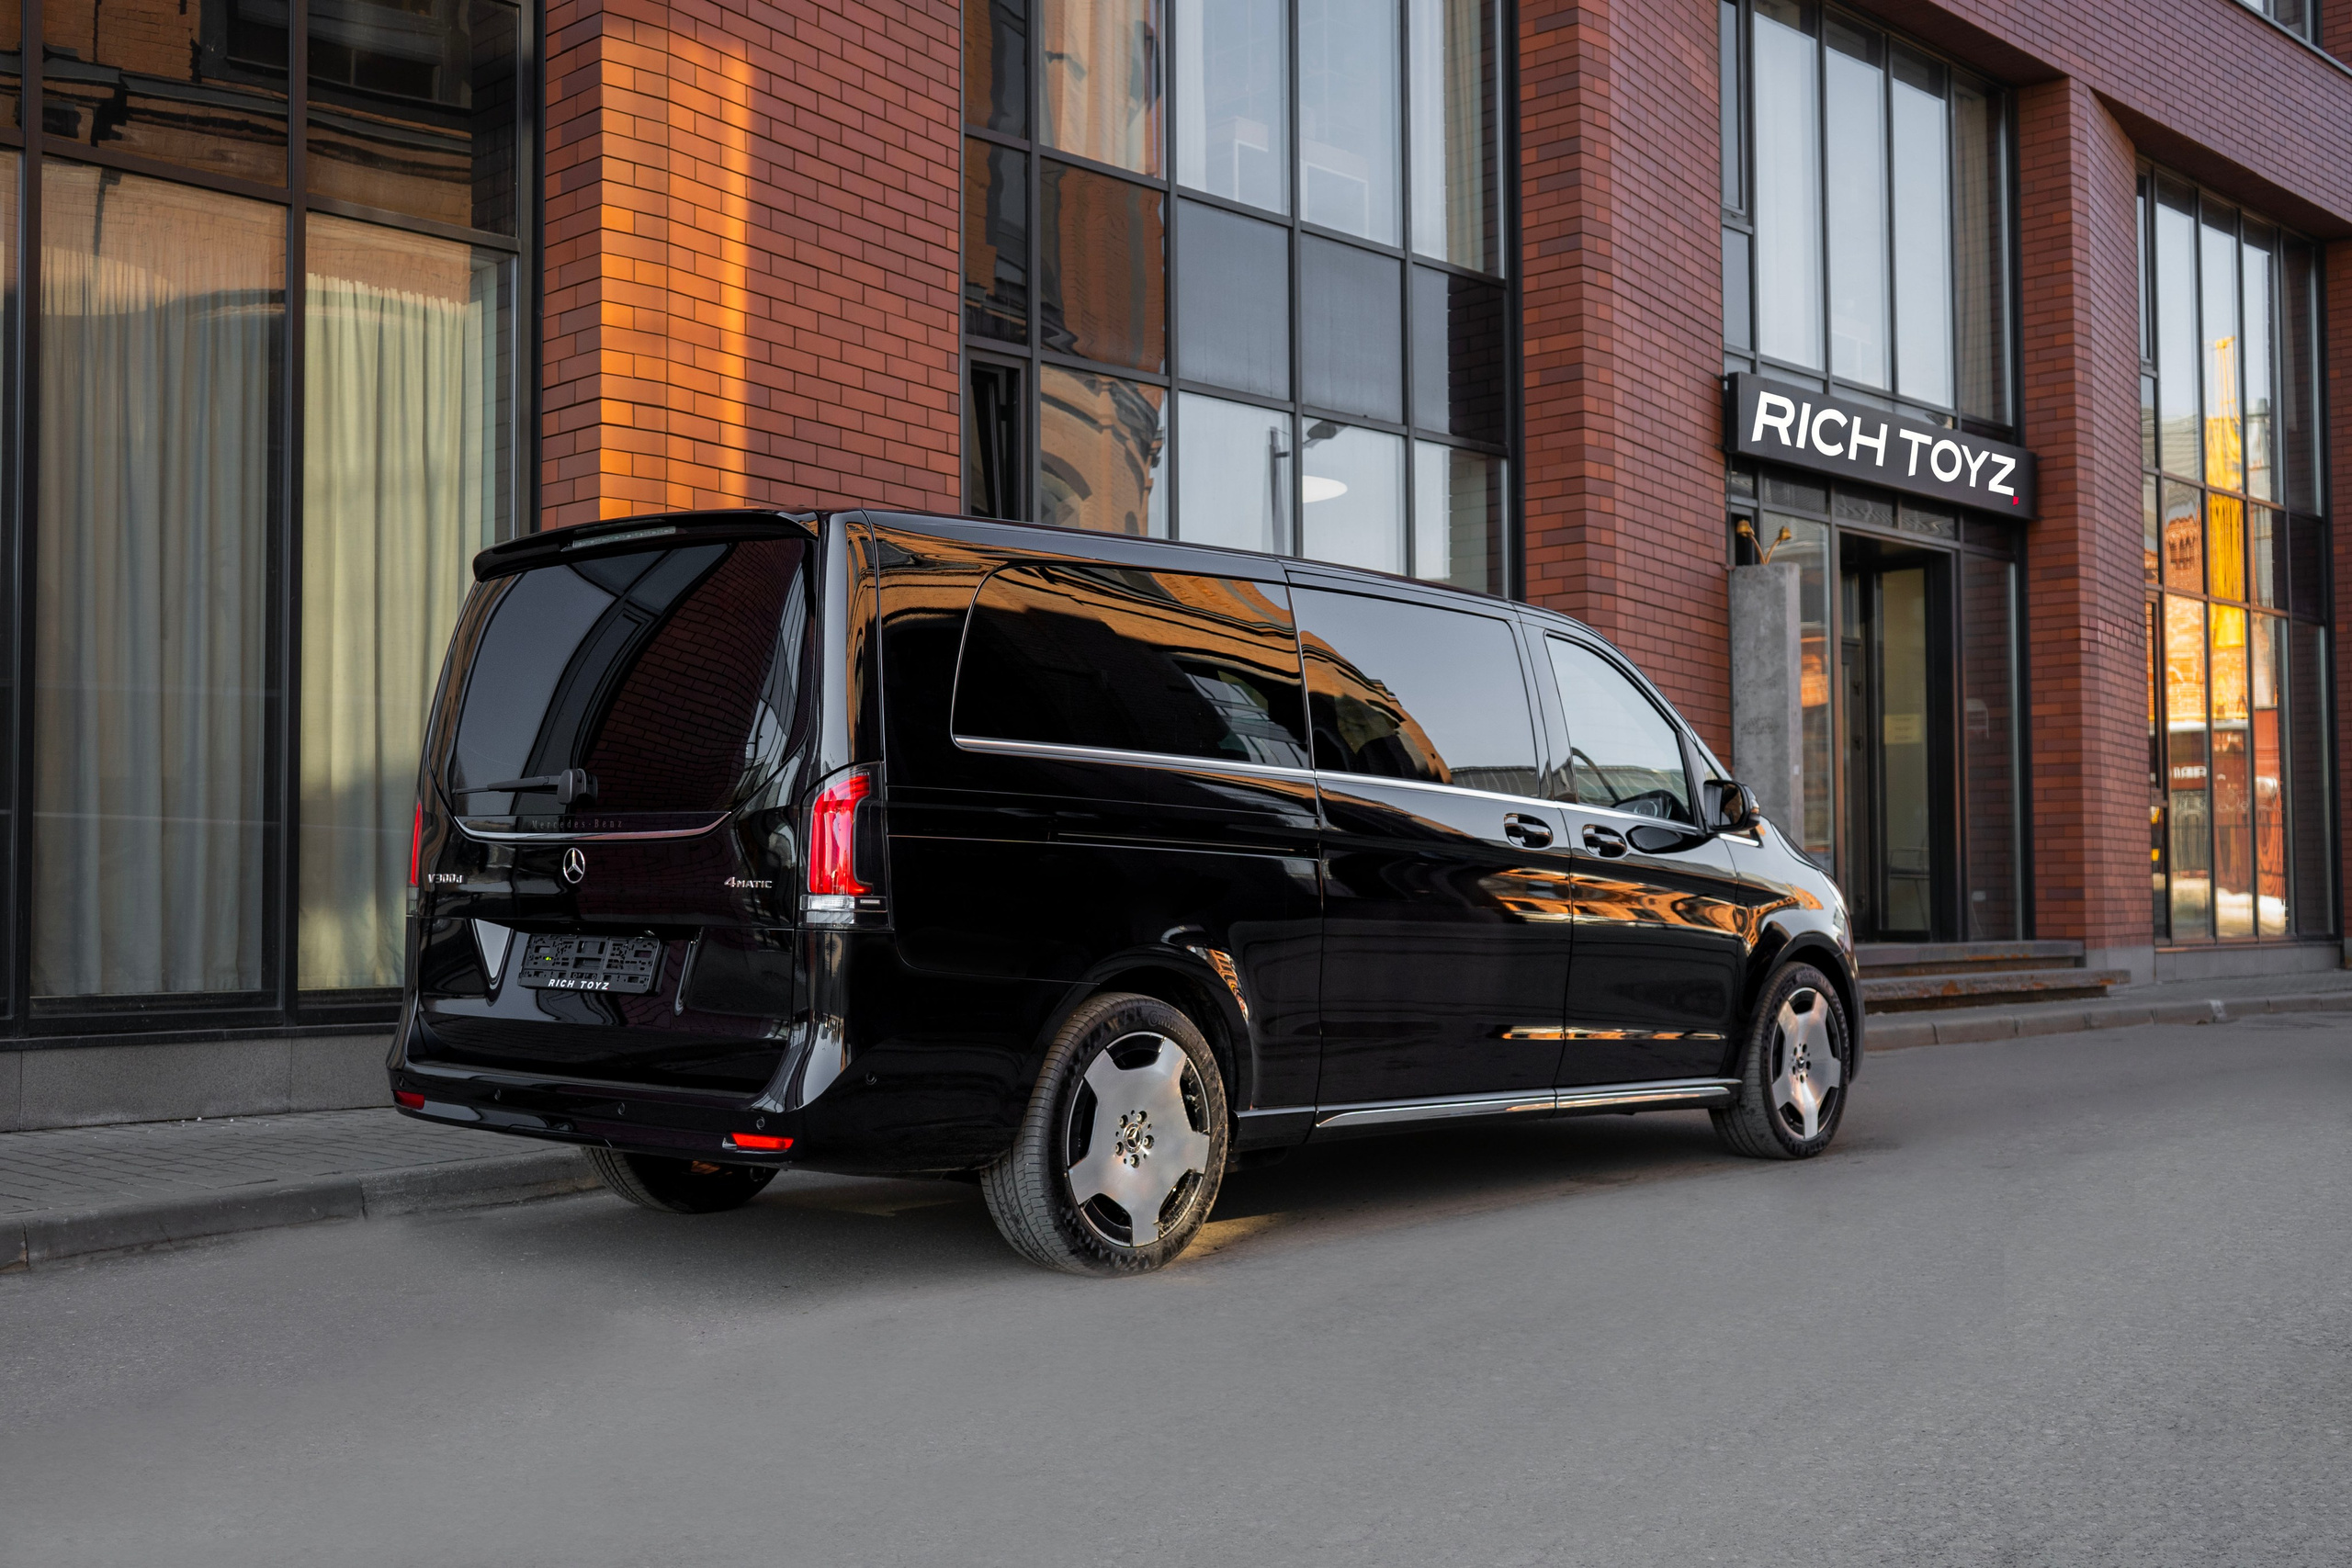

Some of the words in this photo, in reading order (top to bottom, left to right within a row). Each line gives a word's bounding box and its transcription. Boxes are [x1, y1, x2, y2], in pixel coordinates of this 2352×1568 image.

[1751, 390, 1888, 468] RICH
[724, 876, 773, 888] 4MATIC
[548, 978, 575, 988] RICH
